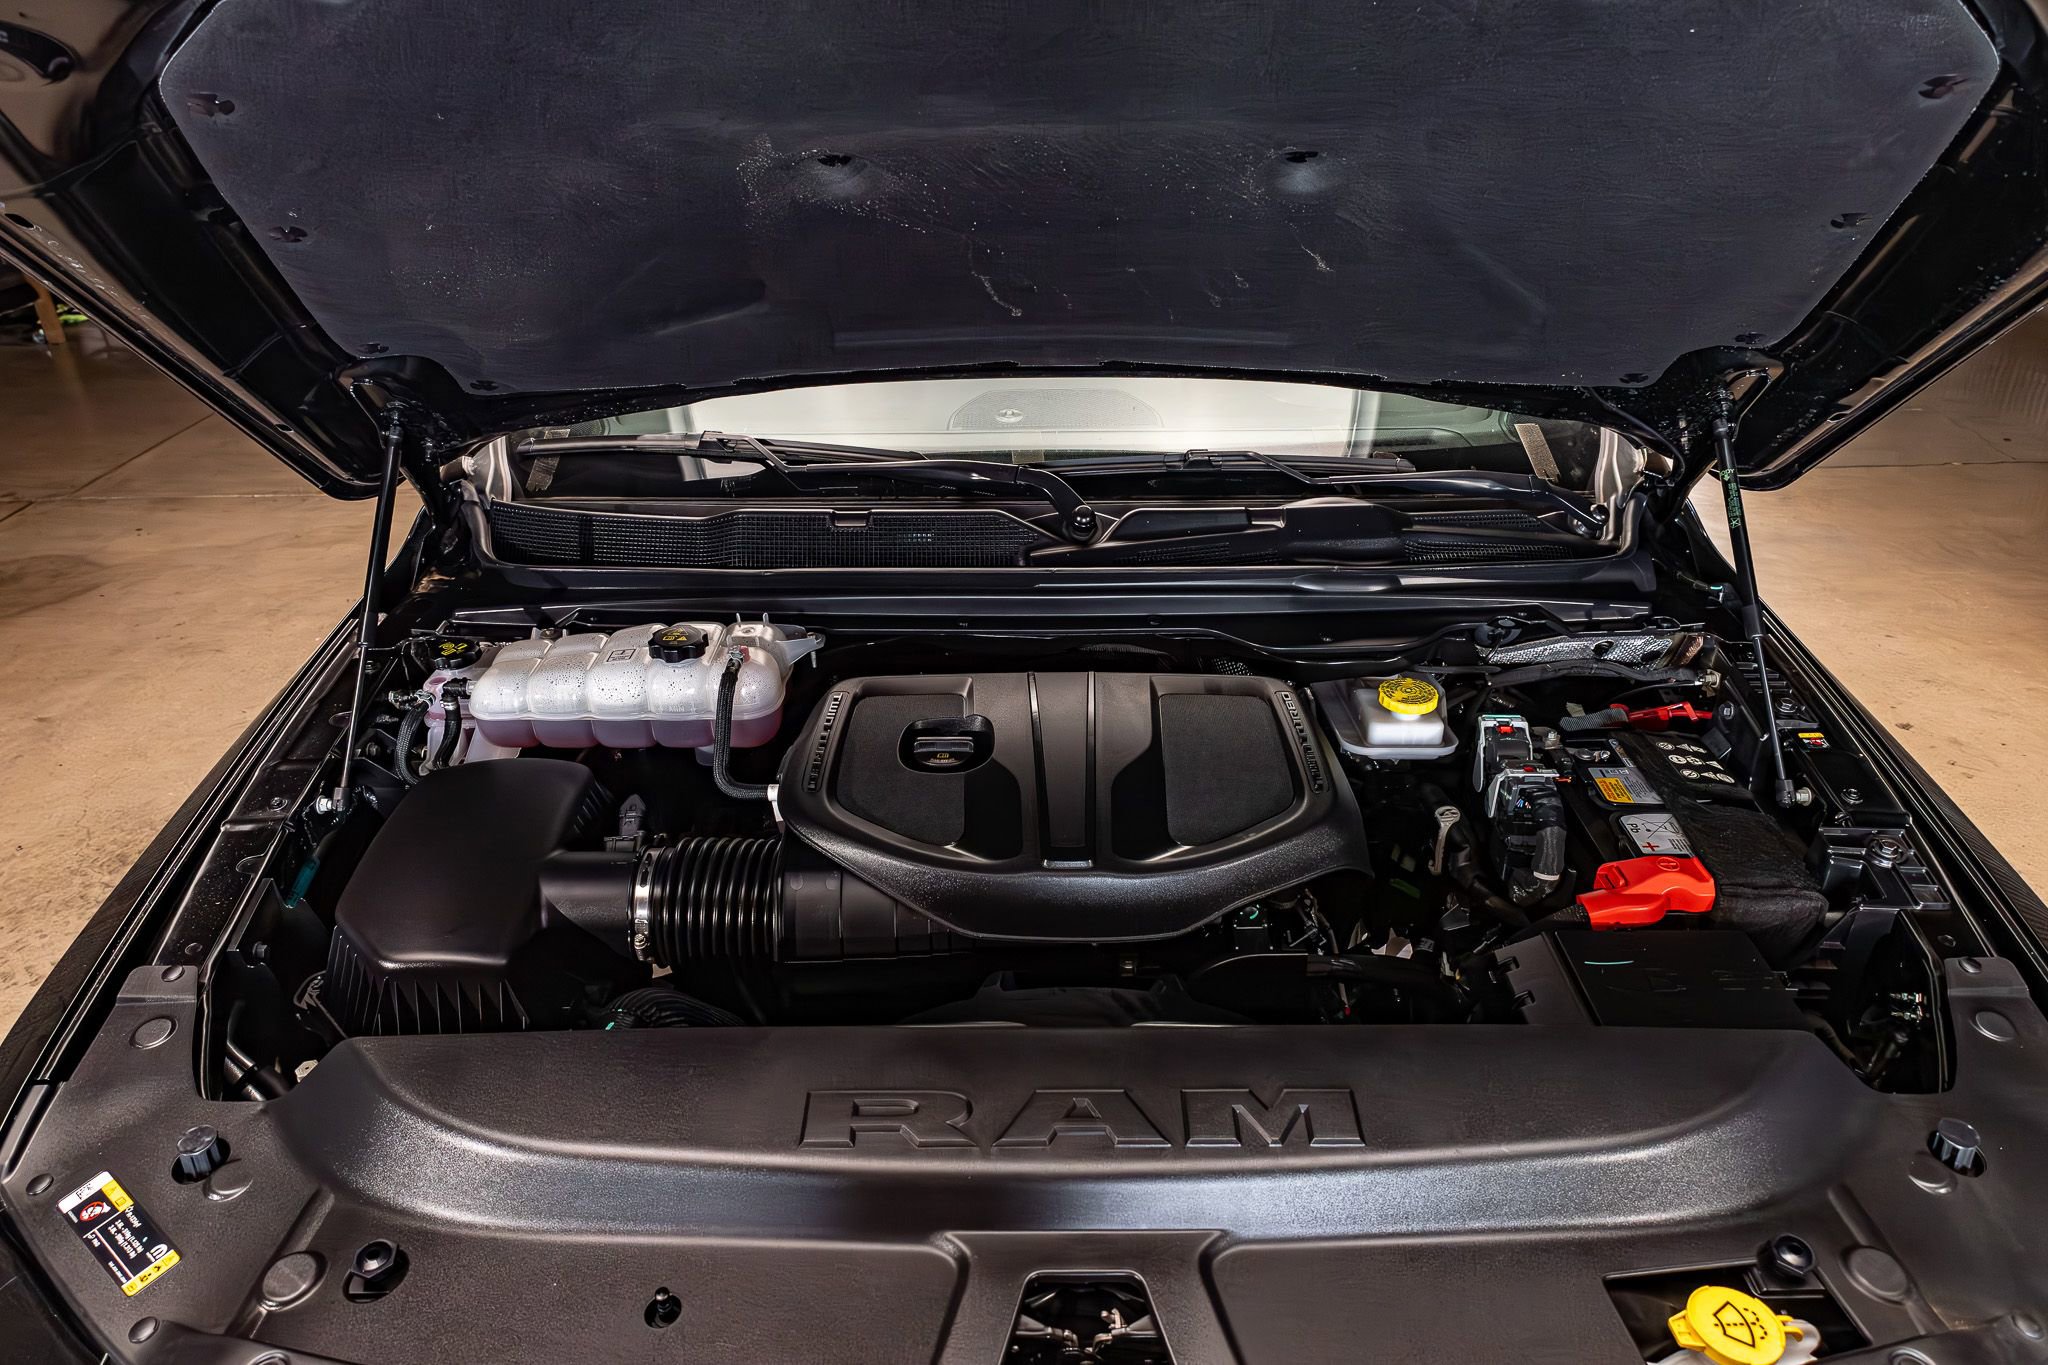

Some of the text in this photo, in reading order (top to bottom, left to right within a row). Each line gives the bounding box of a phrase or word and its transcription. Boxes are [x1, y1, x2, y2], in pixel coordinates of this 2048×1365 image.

[824, 693, 843, 724] TWIN
[1282, 691, 1308, 744] TURBO
[1627, 823, 1639, 834] Pb
[798, 1088, 1368, 1149] RAM
